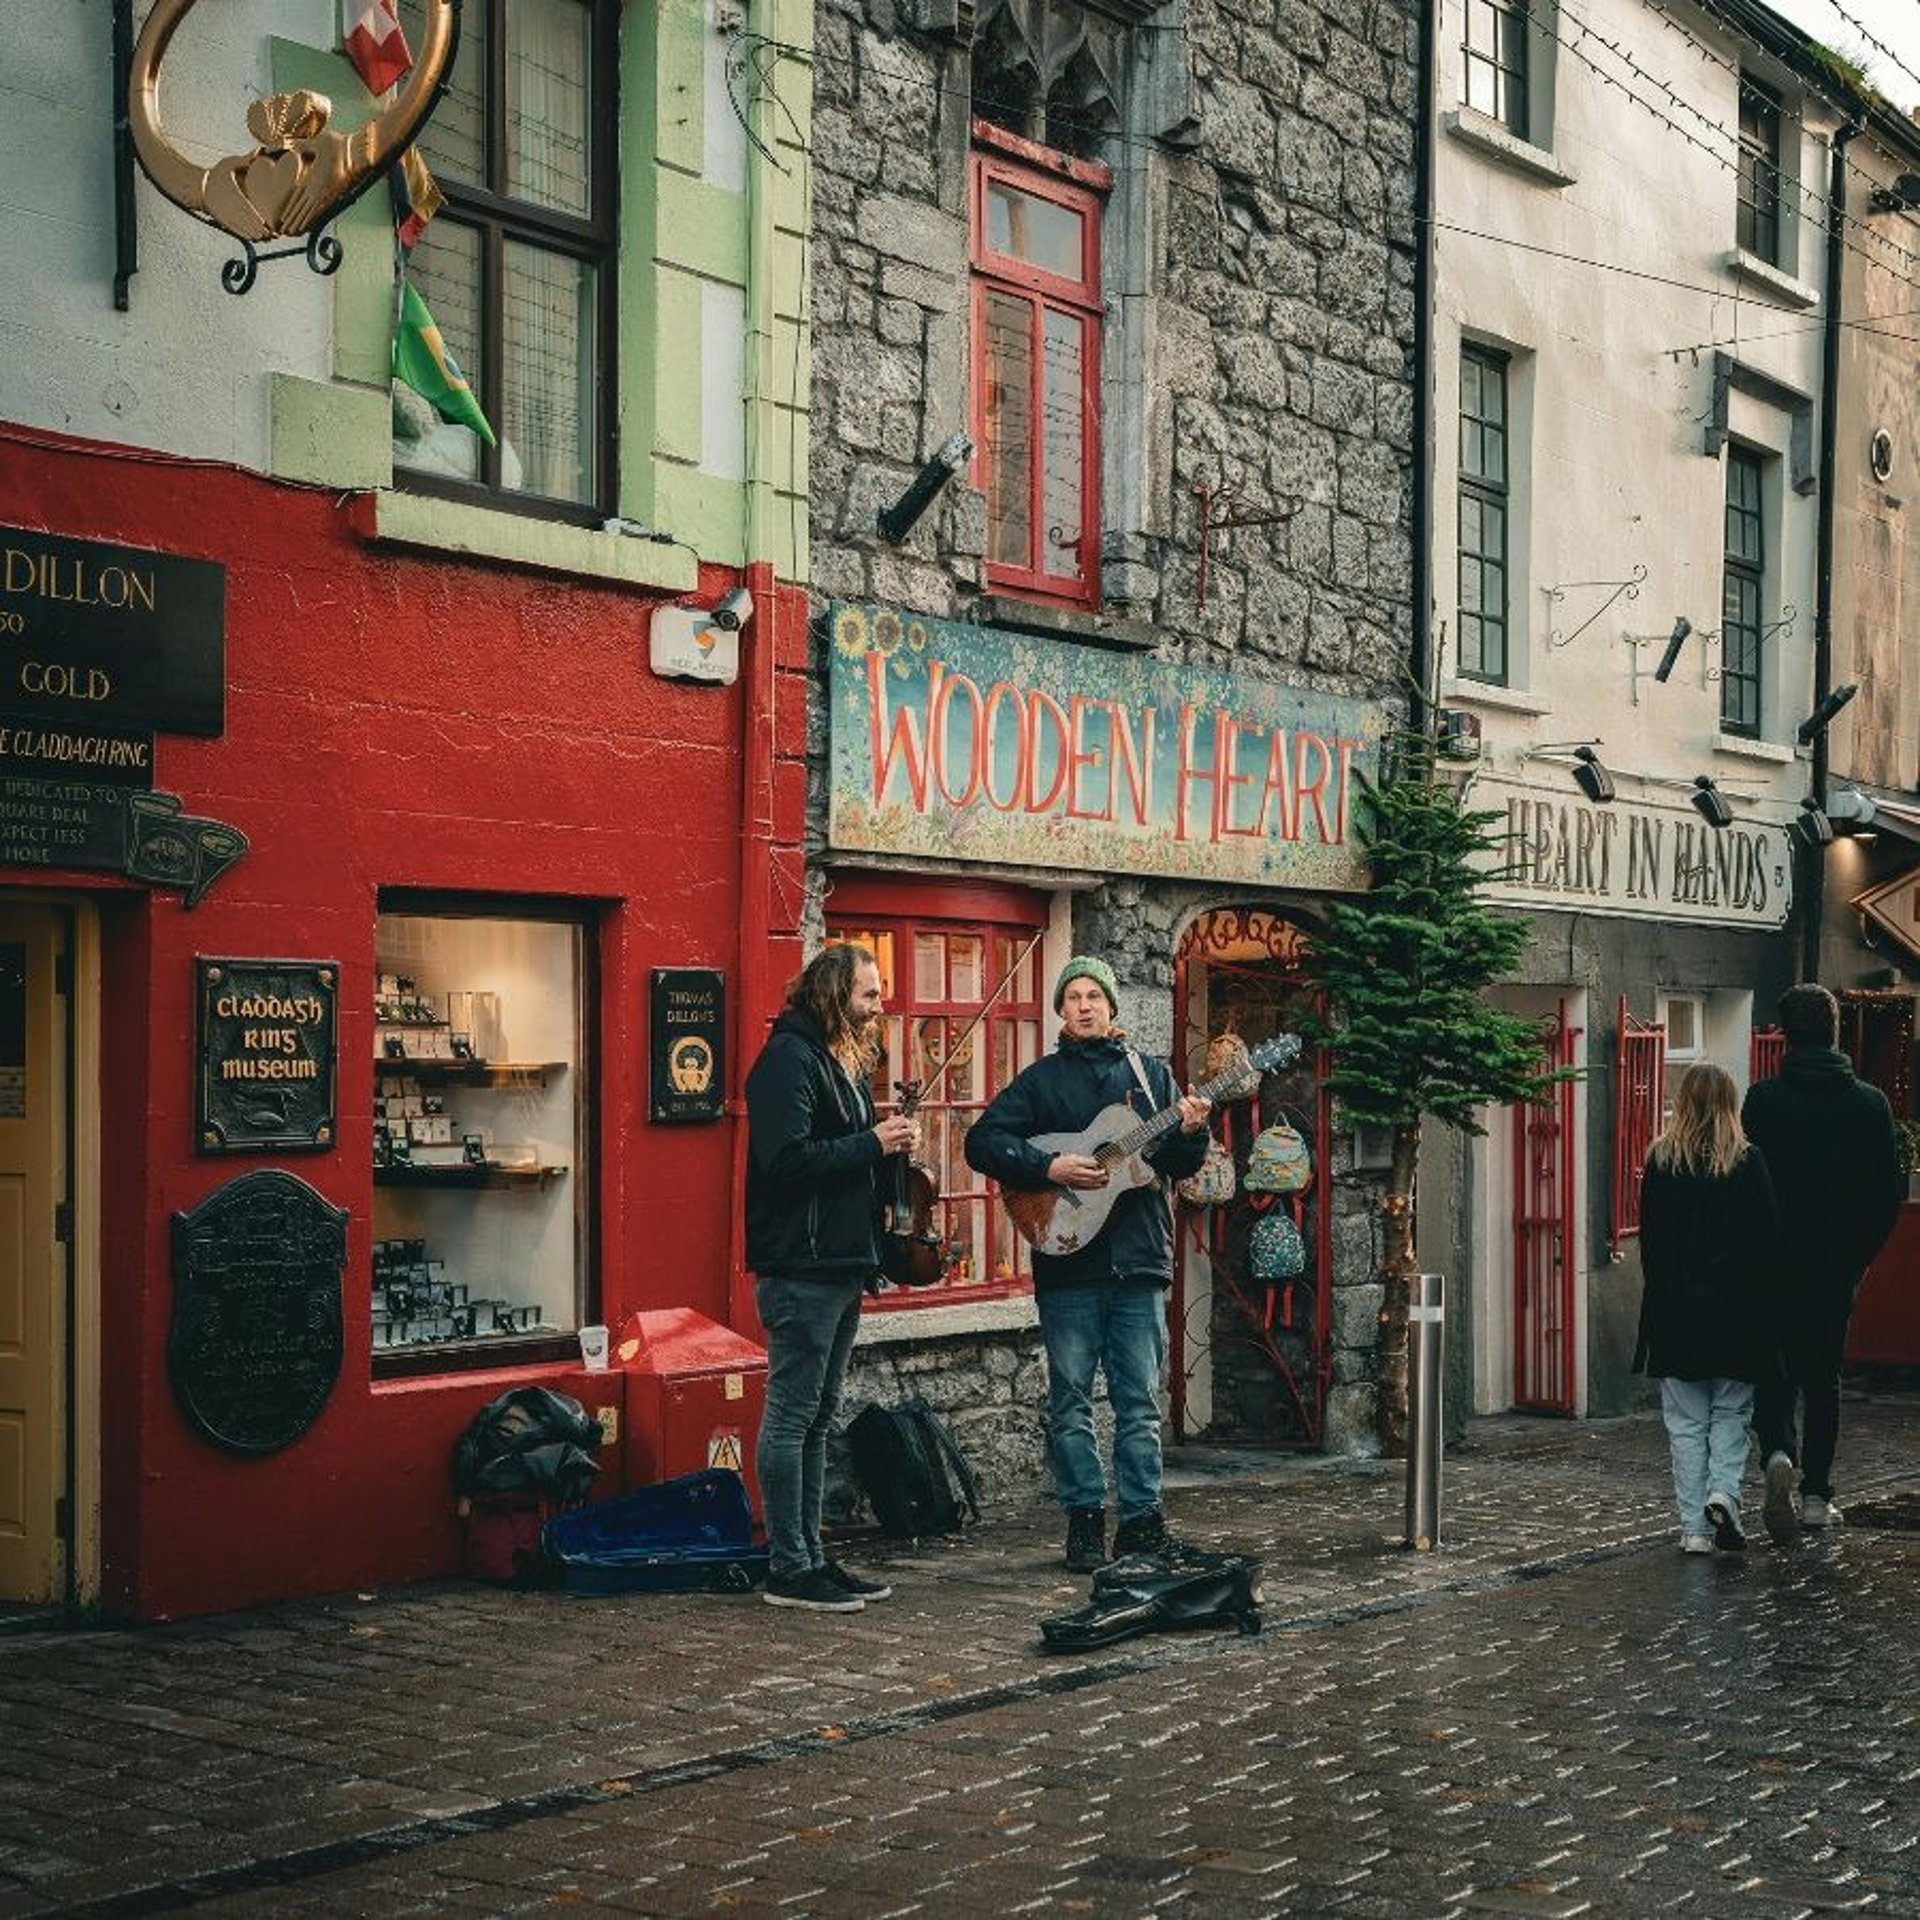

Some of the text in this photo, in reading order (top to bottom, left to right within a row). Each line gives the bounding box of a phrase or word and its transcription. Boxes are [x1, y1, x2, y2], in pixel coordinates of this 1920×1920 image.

[6, 549, 155, 612] DILLON
[21, 662, 111, 701] GOLD
[867, 650, 1368, 847] WOODEN HEART
[52, 807, 91, 824] DEAL
[1504, 797, 1618, 896] HEART
[1626, 814, 1664, 900] IN
[1672, 820, 1769, 913] HANDS
[221, 1058, 318, 1079] museum
